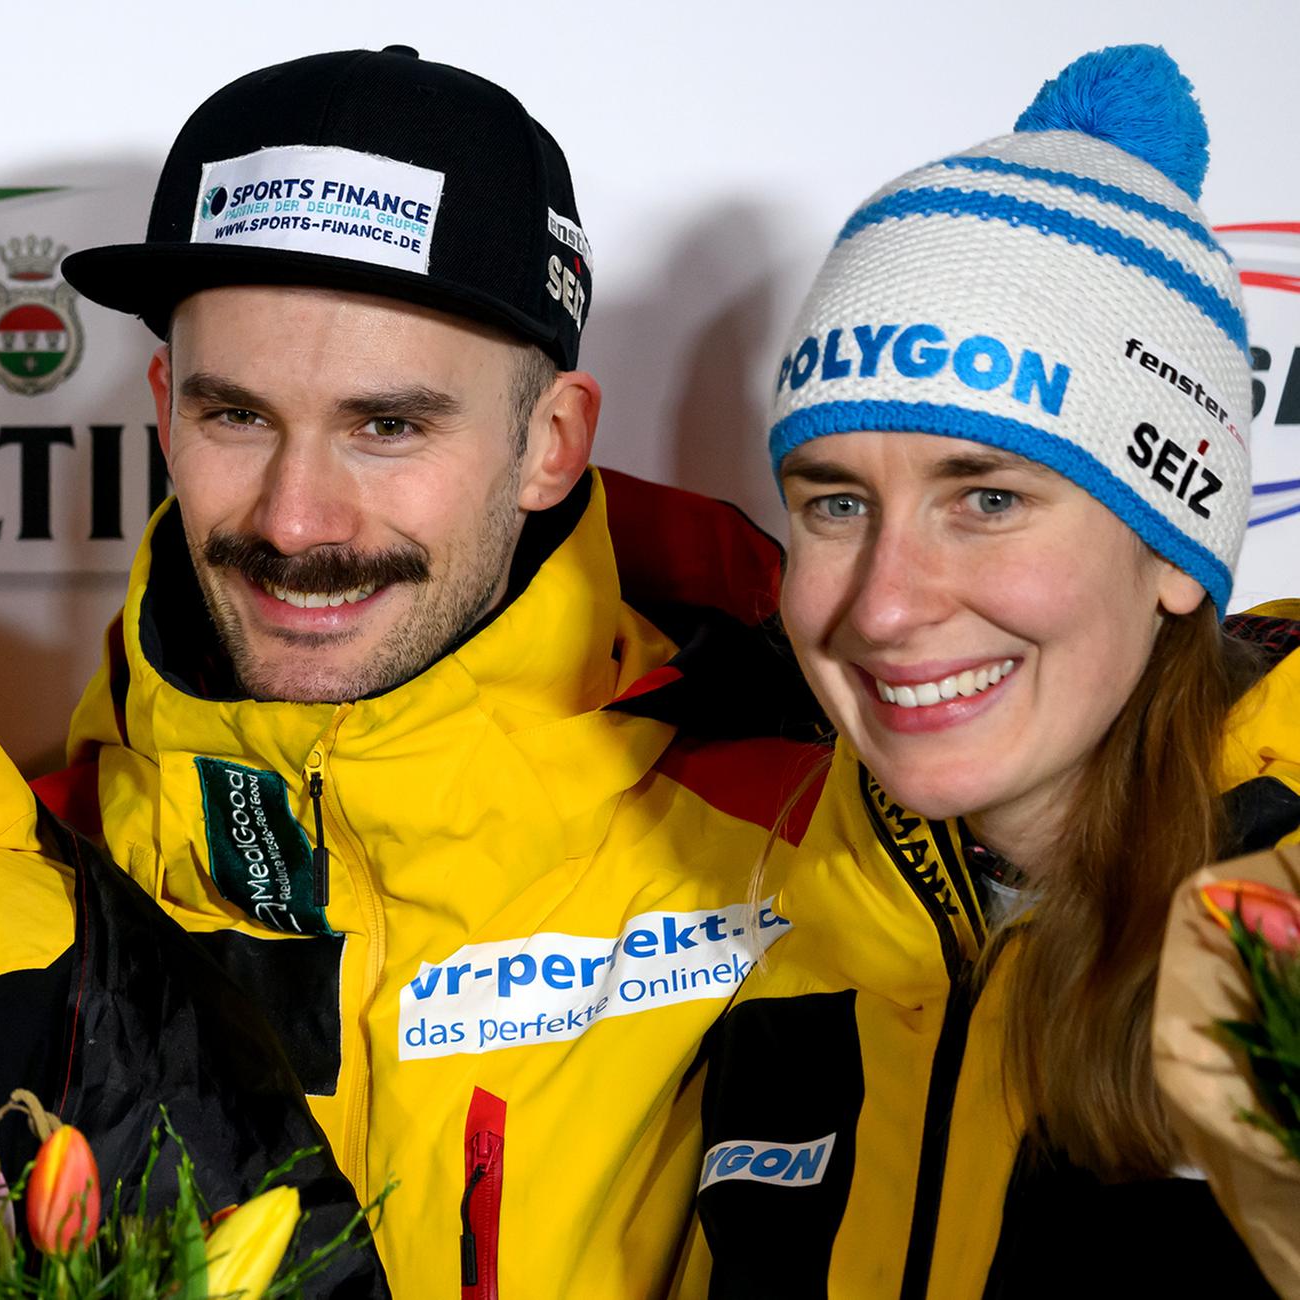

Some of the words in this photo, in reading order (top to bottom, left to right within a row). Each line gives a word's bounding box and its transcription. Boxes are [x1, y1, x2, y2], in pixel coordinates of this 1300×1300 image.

[223, 201, 268, 220] PARTNER
[275, 200, 300, 213] DER
[377, 212, 427, 238] GRUPPE
[230, 179, 314, 207] SPORTS
[321, 181, 431, 225] FINANCE
[215, 216, 421, 253] WWW.SPORTS-FINANCE.DE
[776, 324, 1072, 417] POLYGON
[249, 773, 262, 805] Good
[405, 1018, 466, 1048] das
[478, 996, 608, 1049] perfekte
